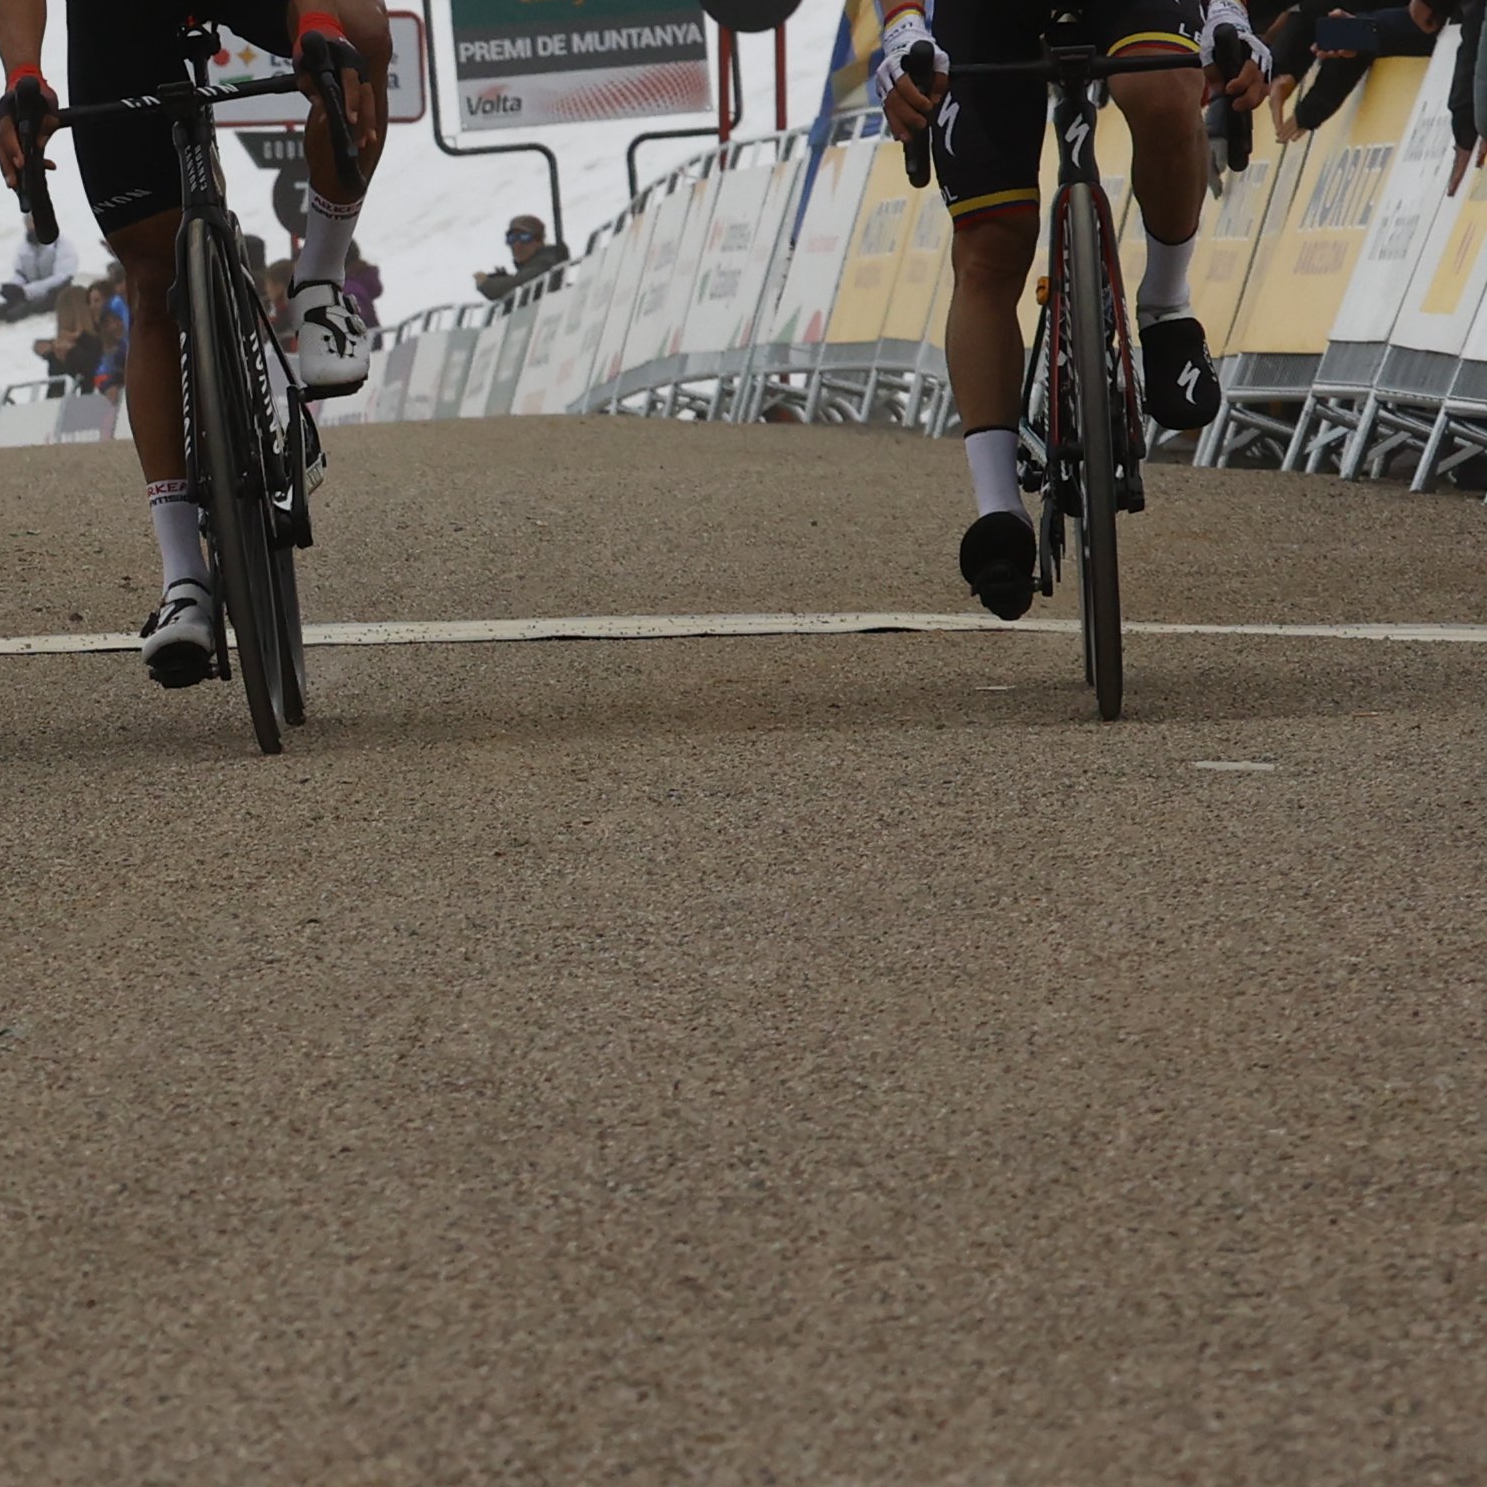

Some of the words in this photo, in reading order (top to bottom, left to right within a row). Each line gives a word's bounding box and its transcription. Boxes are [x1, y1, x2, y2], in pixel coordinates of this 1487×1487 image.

[458, 35, 533, 65] PREMI
[537, 32, 568, 59] DE
[570, 21, 703, 55] MUNTANYA
[465, 92, 523, 116] Volta
[1297, 143, 1395, 232] MORITZ
